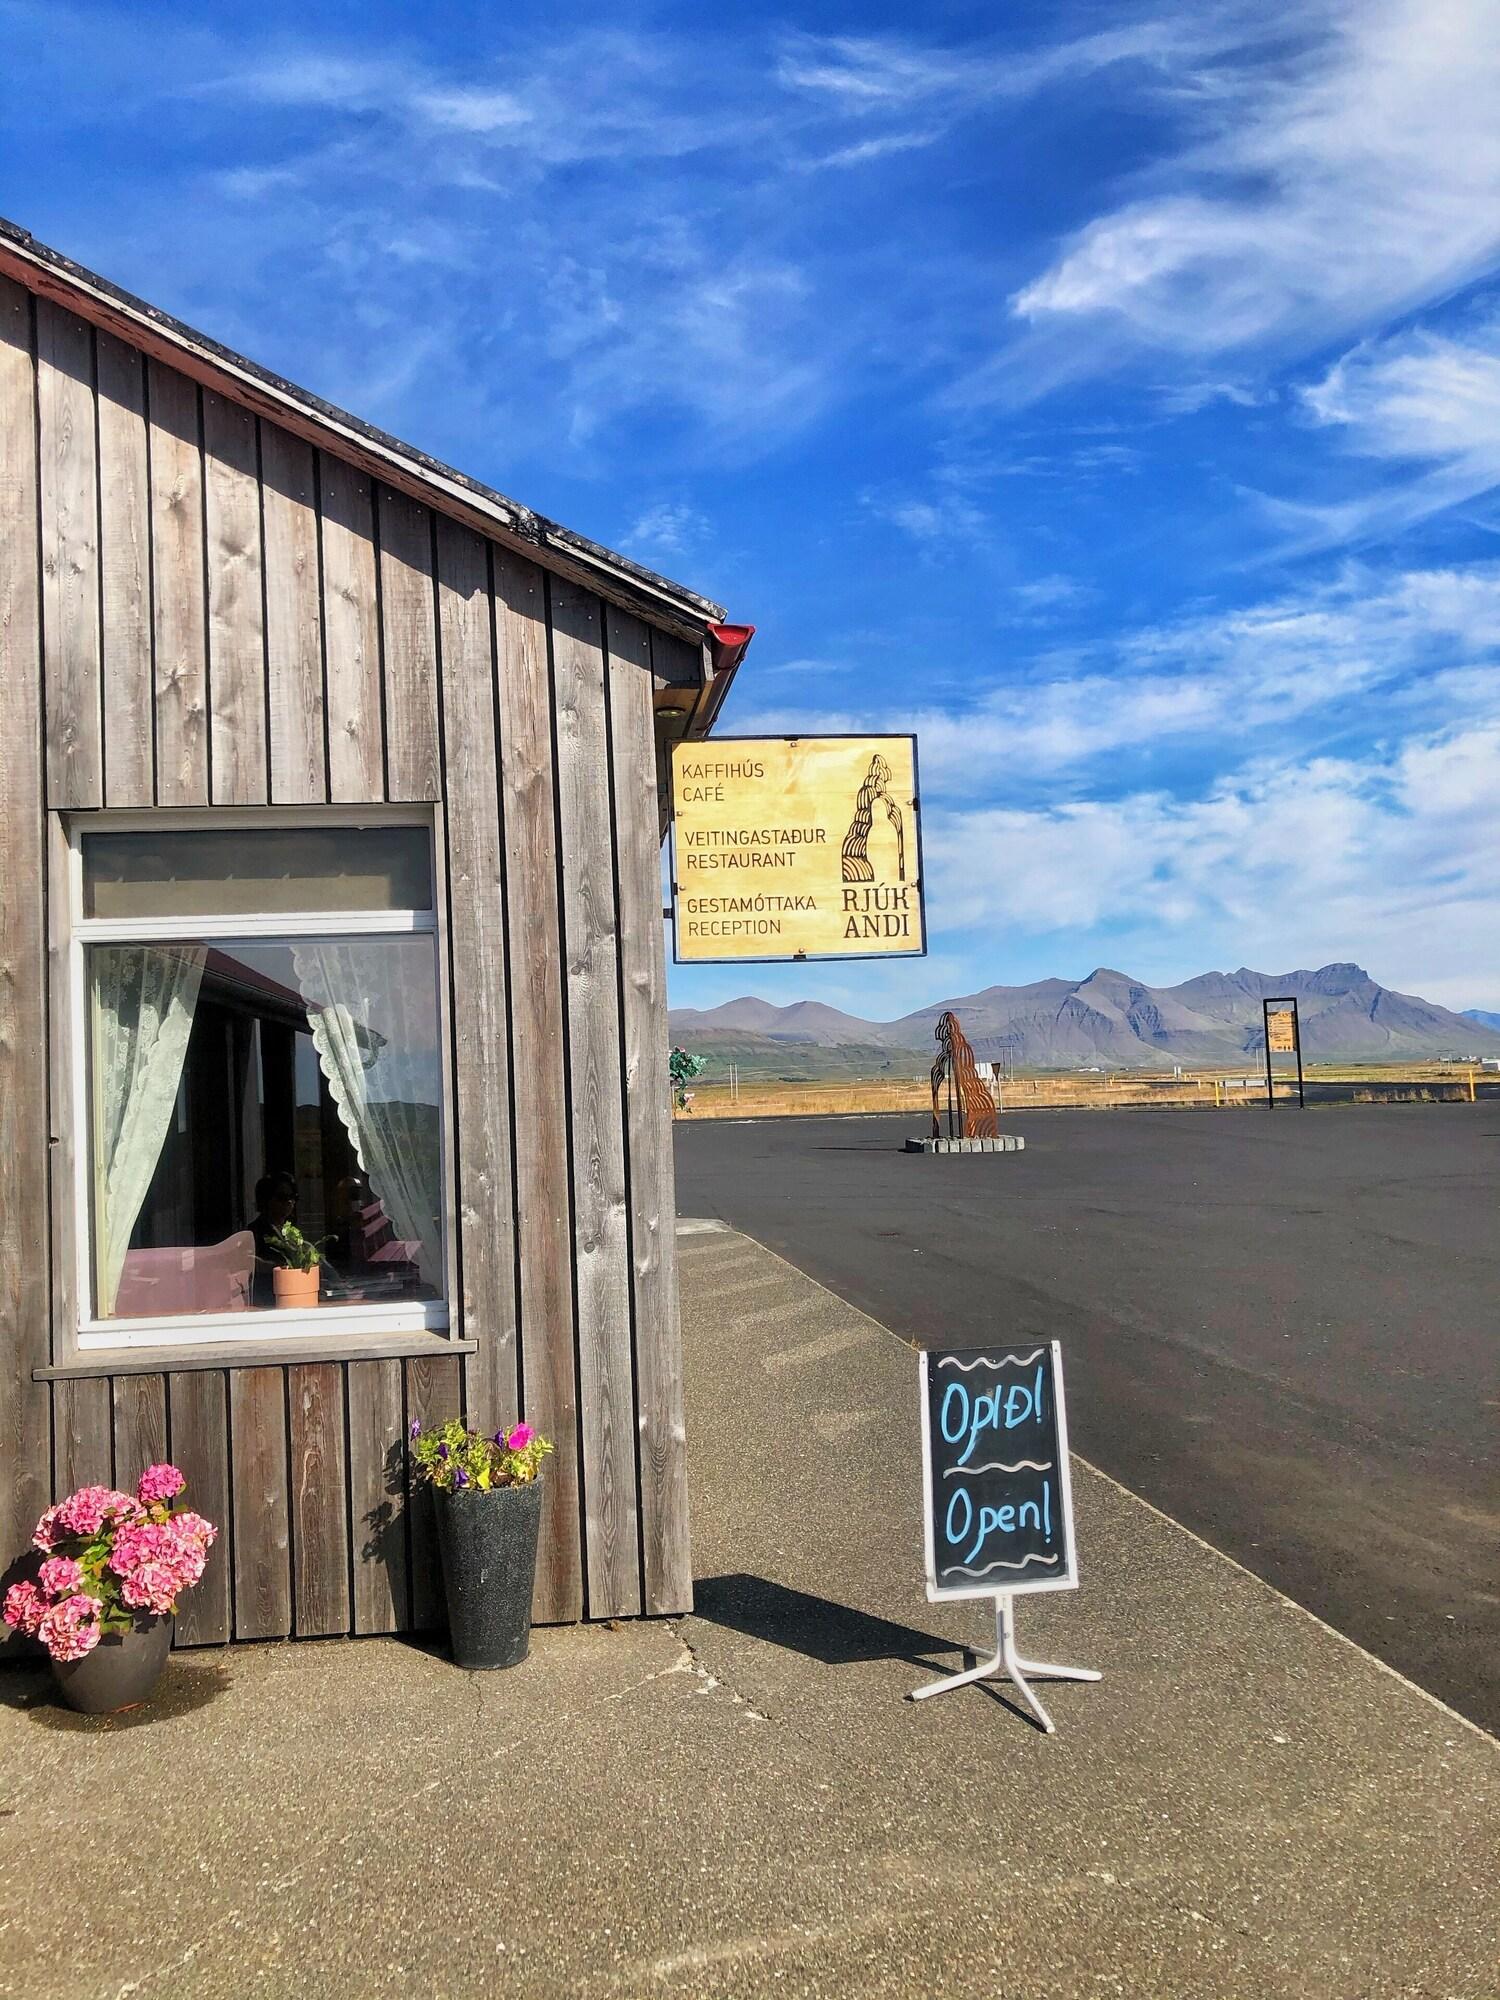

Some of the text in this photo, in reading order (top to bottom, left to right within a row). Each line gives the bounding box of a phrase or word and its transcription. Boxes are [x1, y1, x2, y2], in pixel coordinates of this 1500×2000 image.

[682, 759, 764, 779] KAFFIHÚS
[682, 783, 725, 802] CAFÉ
[685, 828, 826, 847] VEITINGASTAÐUR
[687, 852, 796, 869] RESTAURANT
[687, 893, 817, 913] GESTAMÓTTAKA
[841, 883, 910, 912] RJÚK
[688, 920, 781, 936] RECEPTION
[843, 914, 911, 939] ANDI
[945, 1480, 1052, 1565] Open!
